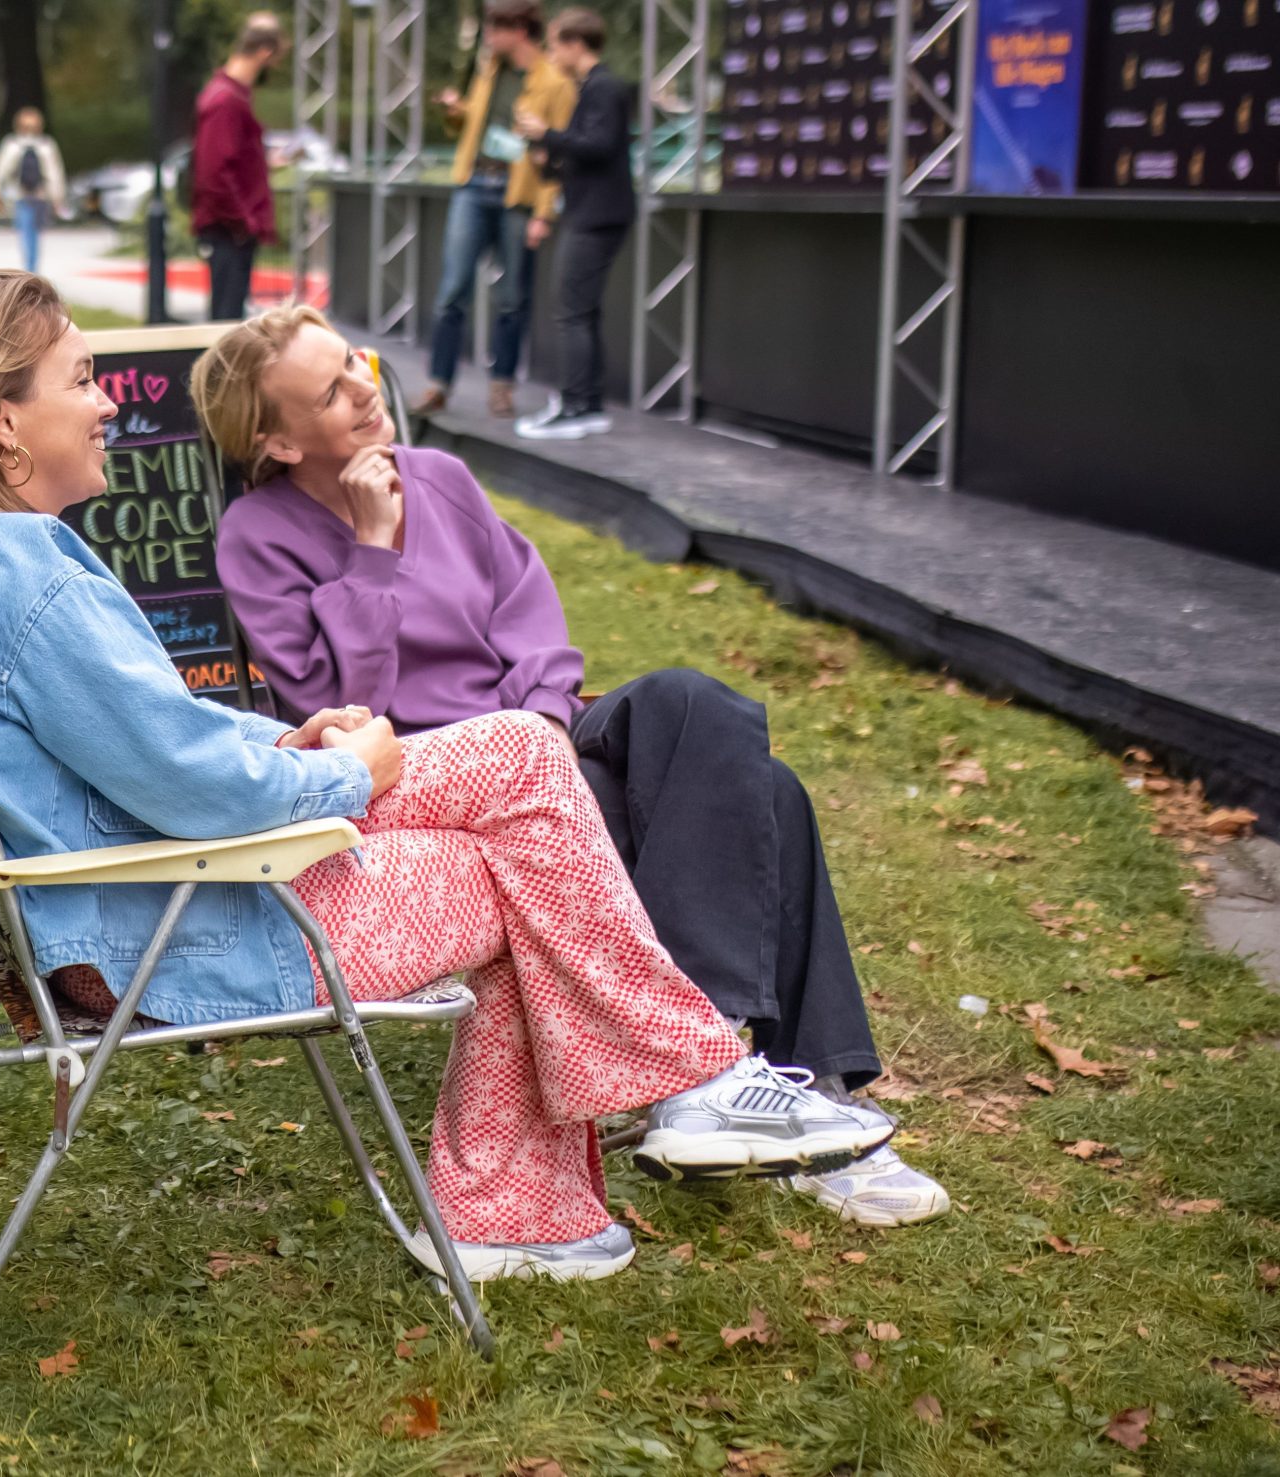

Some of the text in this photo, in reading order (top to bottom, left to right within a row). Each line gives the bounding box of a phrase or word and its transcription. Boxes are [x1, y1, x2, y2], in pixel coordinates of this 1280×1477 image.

[97, 366, 143, 405] OM
[125, 409, 162, 434] de
[104, 442, 224, 496] EMIN
[106, 536, 209, 584] MPE
